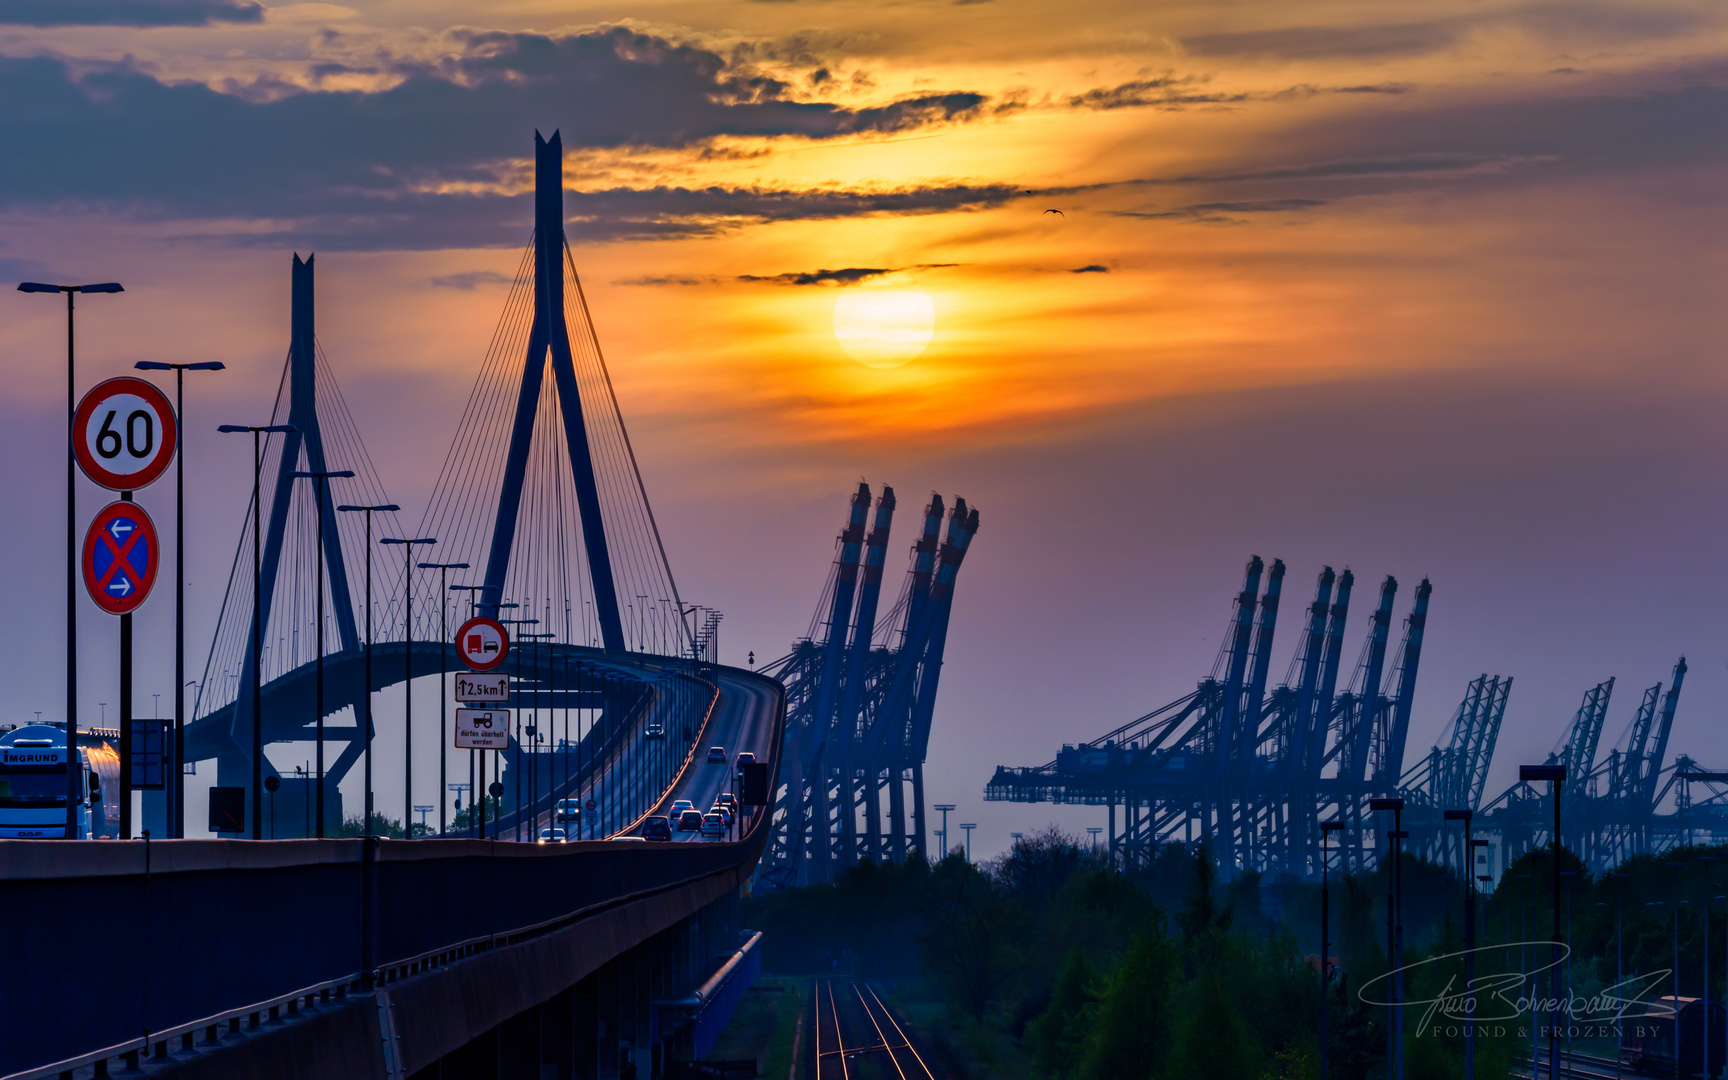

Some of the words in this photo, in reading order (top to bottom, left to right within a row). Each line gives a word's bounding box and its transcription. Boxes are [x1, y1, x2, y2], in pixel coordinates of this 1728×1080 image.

[96, 410, 153, 459] 60
[461, 729, 479, 737] dürfen
[481, 730, 504, 738] überholt
